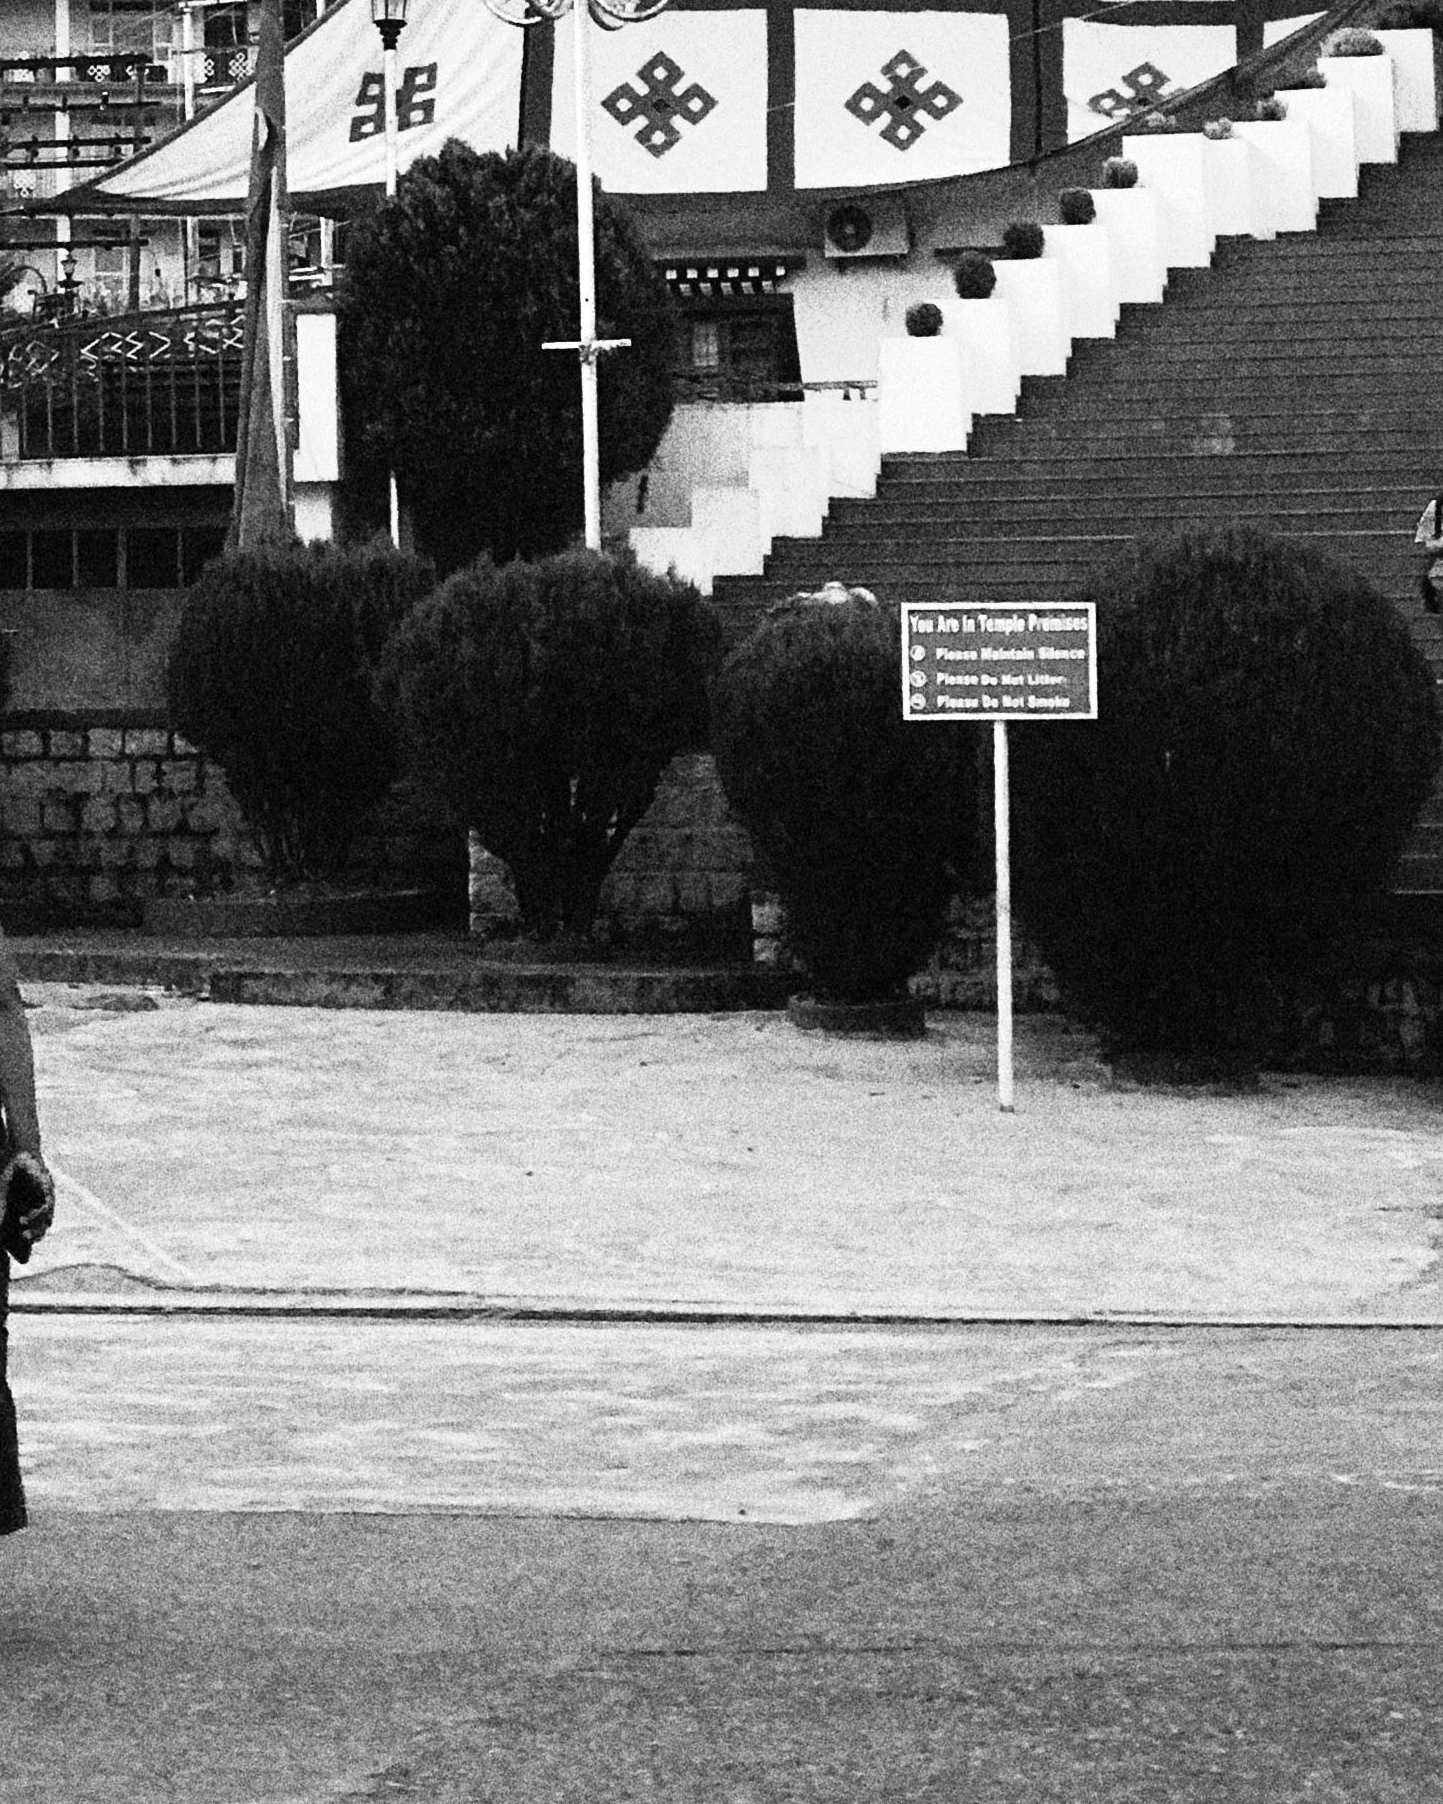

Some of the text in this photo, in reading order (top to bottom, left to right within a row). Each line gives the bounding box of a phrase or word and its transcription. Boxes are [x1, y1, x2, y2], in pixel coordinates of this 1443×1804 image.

[910, 613, 1087, 637] You Are In Temple Premises
[936, 647, 1085, 661] Please Maintain Silence
[937, 672, 978, 686] Please
[981, 674, 998, 686] Do
[1001, 674, 1024, 686] Not
[937, 694, 1070, 709] Please Do Not Smoke
